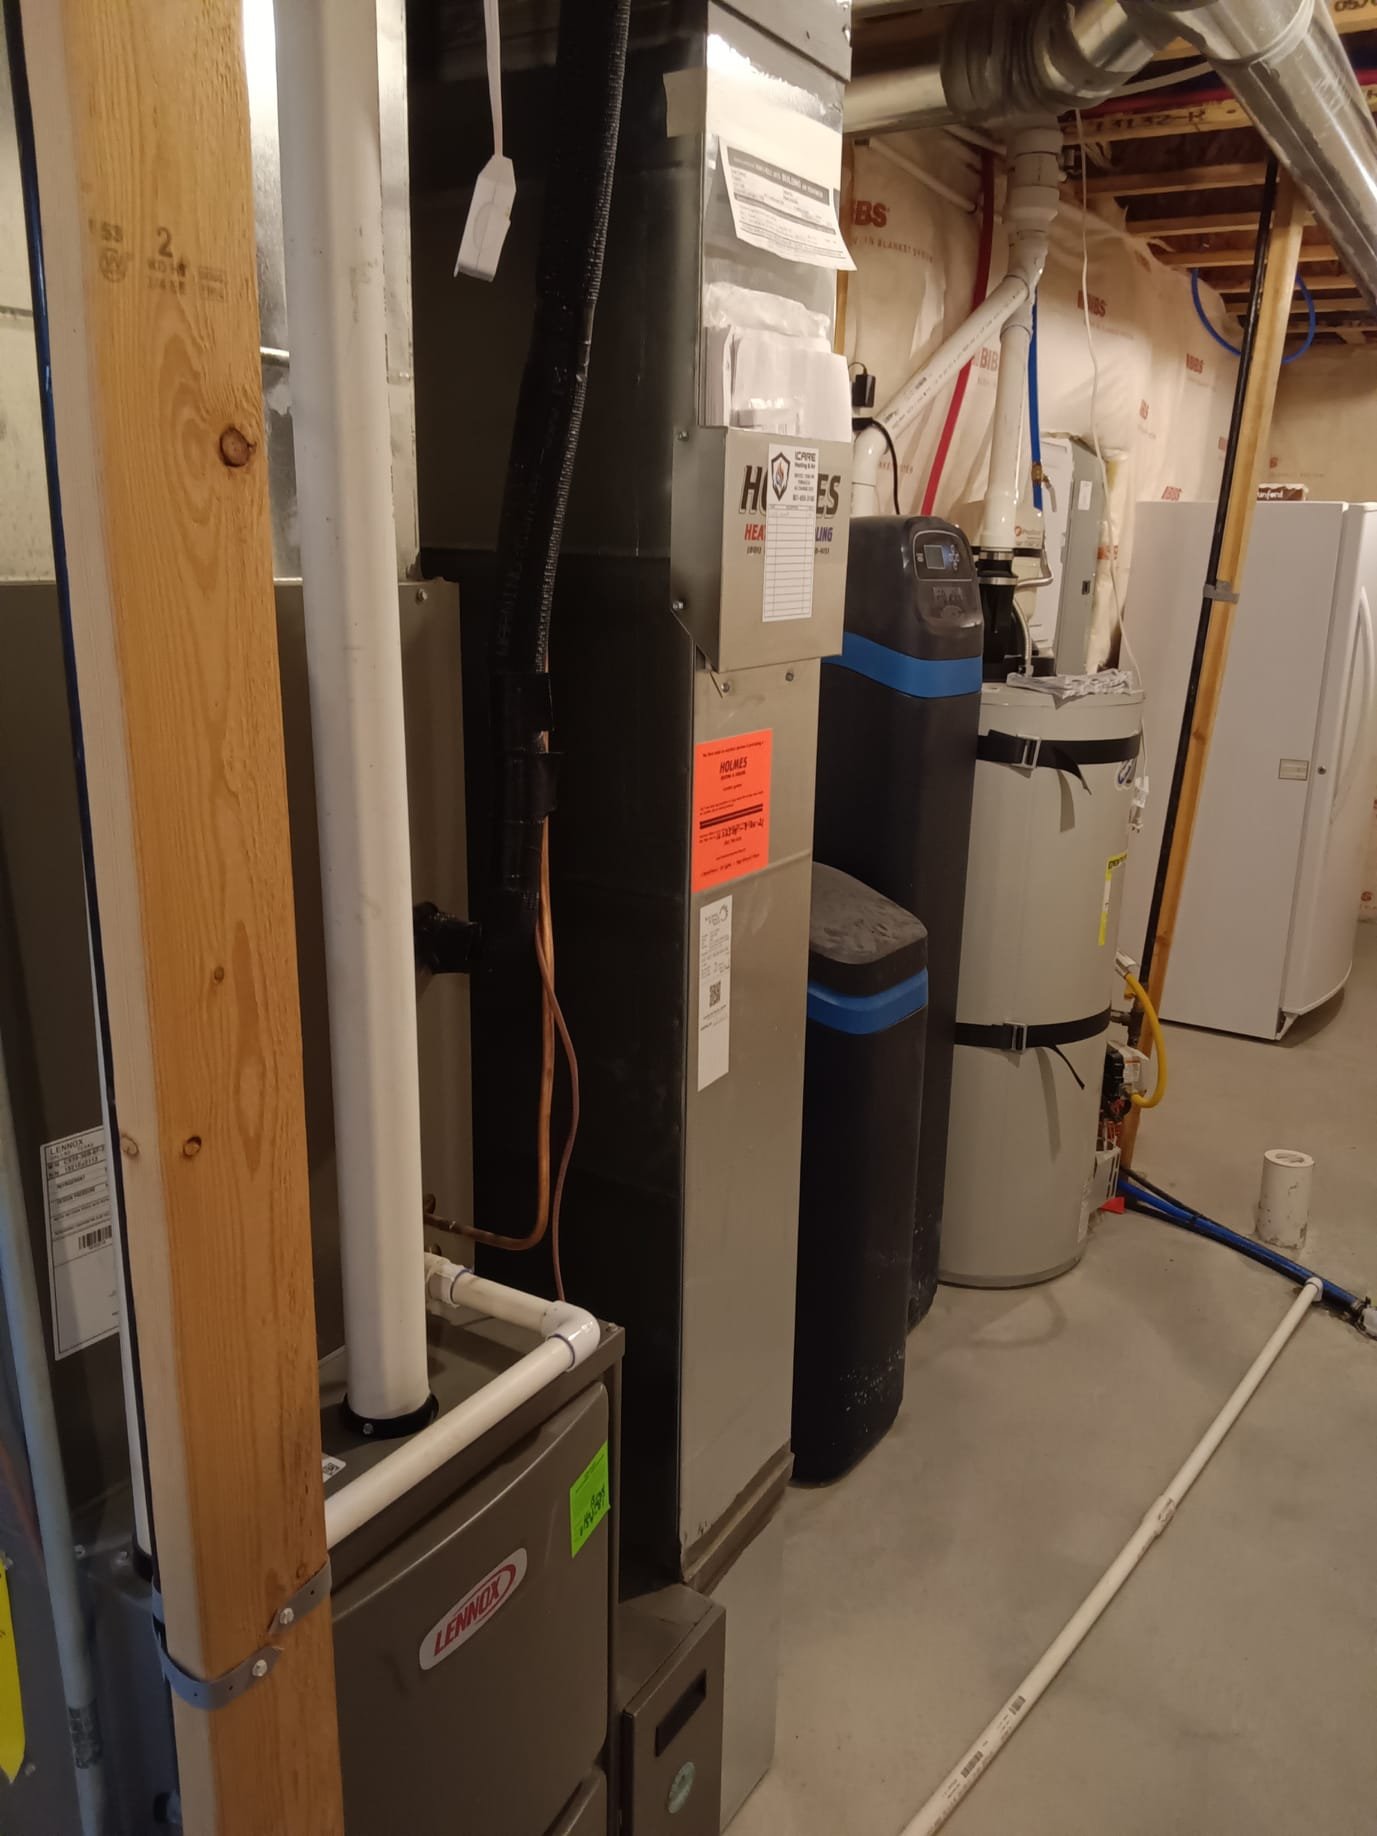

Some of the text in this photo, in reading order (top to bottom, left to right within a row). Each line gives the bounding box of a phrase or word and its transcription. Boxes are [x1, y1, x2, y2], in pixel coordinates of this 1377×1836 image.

[157, 227, 173, 258] 2
[739, 465, 841, 519] HES
[1257, 489, 1283, 500] unford
[815, 526, 833, 542] LING
[719, 756, 748, 774] HOLMES
[49, 1139, 83, 1155] LENNOX
[433, 1574, 501, 1657] LENNOX
